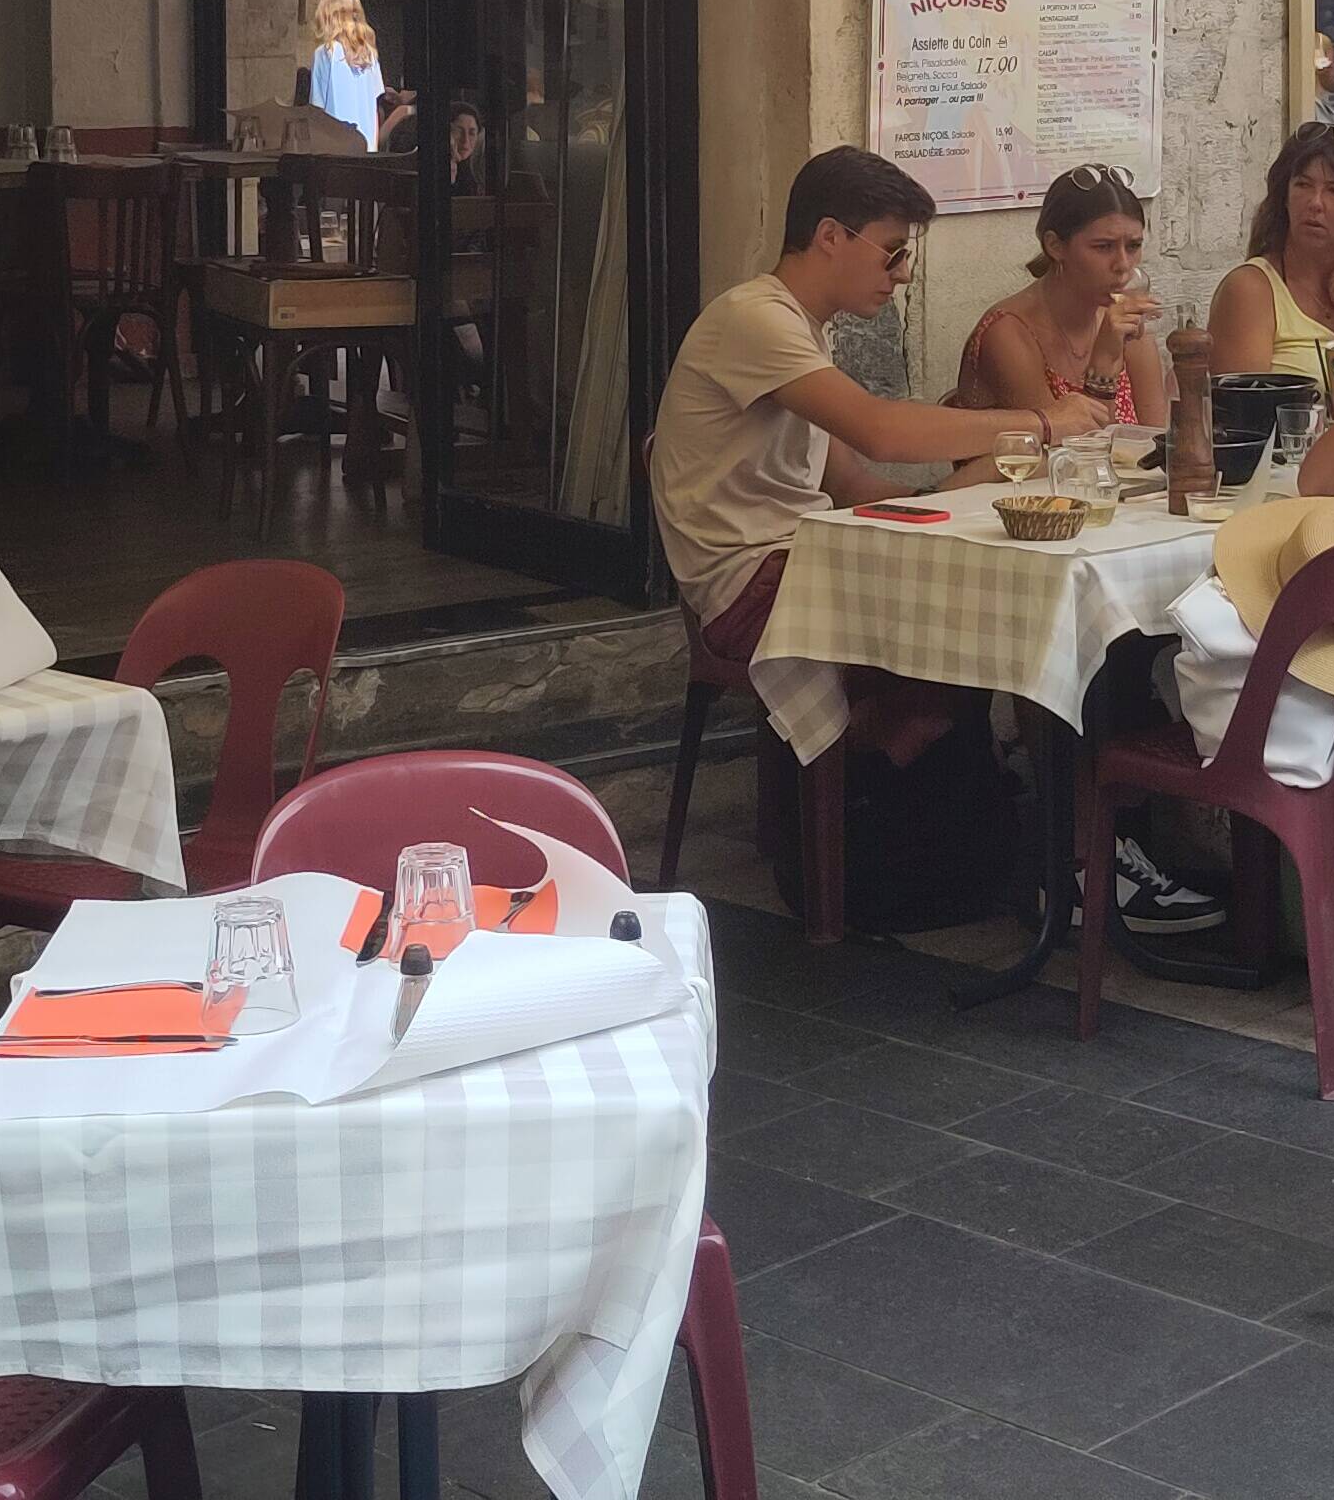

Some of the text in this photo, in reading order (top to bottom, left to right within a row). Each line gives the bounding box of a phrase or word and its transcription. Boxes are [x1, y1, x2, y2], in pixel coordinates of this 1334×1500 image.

[911, 35, 991, 51] Assiette du Coin
[976, 56, 1018, 75] 17.90
[904, 96, 939, 107] partager
[949, 96, 959, 104] ou
[960, 94, 975, 104] pas
